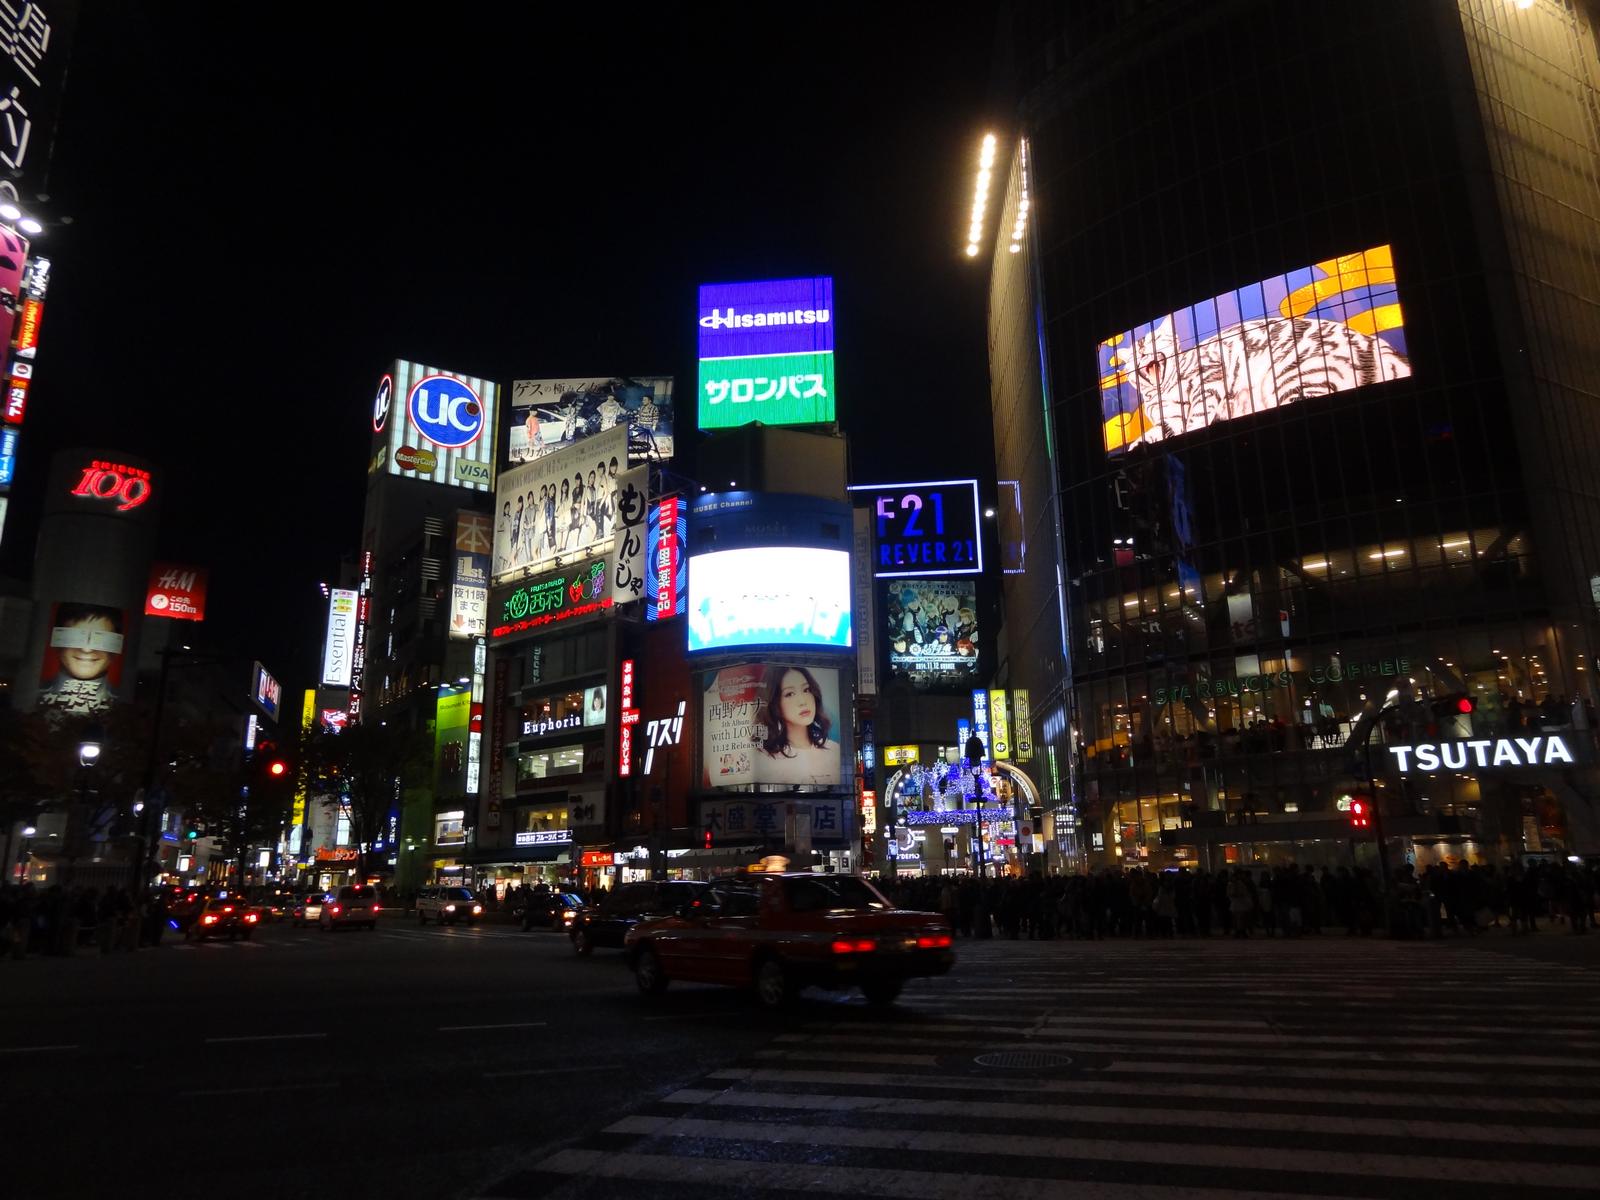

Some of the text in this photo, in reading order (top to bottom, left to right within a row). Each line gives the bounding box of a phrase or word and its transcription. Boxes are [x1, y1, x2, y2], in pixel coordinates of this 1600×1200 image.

[699, 308, 830, 329] Hisamitsu
[704, 373, 828, 404] サロンパス
[418, 389, 478, 431] UC
[396, 453, 437, 469] MasterCard
[459, 464, 490, 480] VISA
[70, 467, 152, 511] 109
[876, 493, 945, 538] F21
[456, 516, 492, 552] 本
[615, 482, 646, 596] もんじゃ
[657, 503, 672, 613] 三千里薬品
[158, 569, 197, 592] H&M
[169, 602, 197, 614] 150m
[460, 601, 480, 612] まで
[530, 586, 564, 614] 西村
[468, 617, 485, 630] 地下
[325, 612, 347, 683] Essential
[709, 698, 766, 722] 西野カナ
[523, 714, 581, 735] Euphoria
[711, 725, 764, 742] with LOVE
[1389, 736, 1573, 772] TSUTAYA
[705, 804, 837, 833] 大盛堂店
